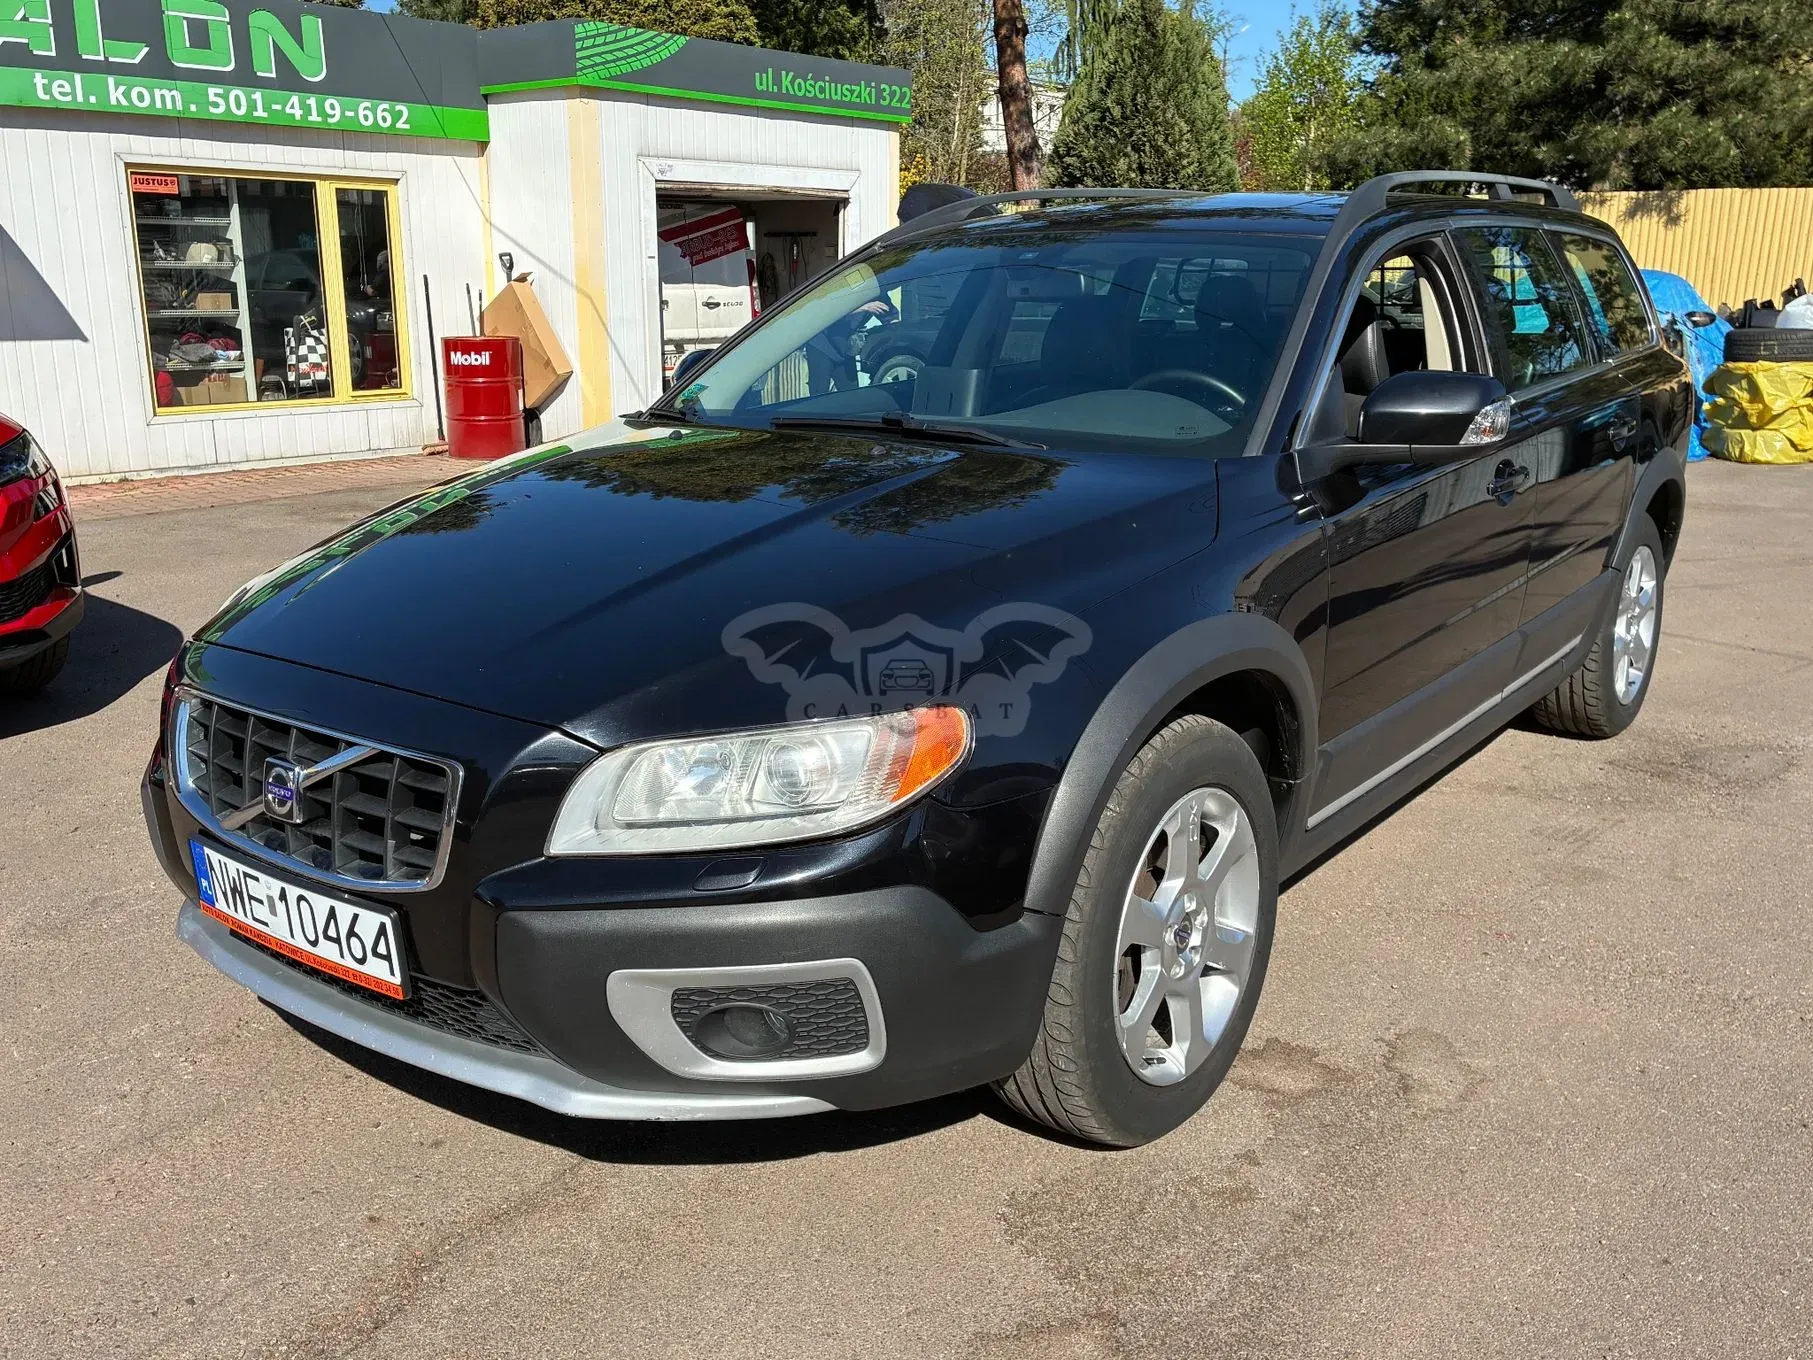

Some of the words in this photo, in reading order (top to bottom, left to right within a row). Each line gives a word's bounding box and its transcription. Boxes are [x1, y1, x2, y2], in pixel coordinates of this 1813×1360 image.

[34, 72, 97, 104] tel.
[107, 77, 197, 112] kom.
[207, 87, 411, 130] 501-419-662
[755, 67, 778, 93] ul.
[781, 70, 876, 105] Kościuszki
[880, 83, 912, 109] 322
[133, 177, 169, 186] JUSTUS
[450, 351, 491, 366] Mobil
[200, 877, 212, 895] PL
[206, 852, 270, 929] NWE
[278, 886, 397, 978] 10464
